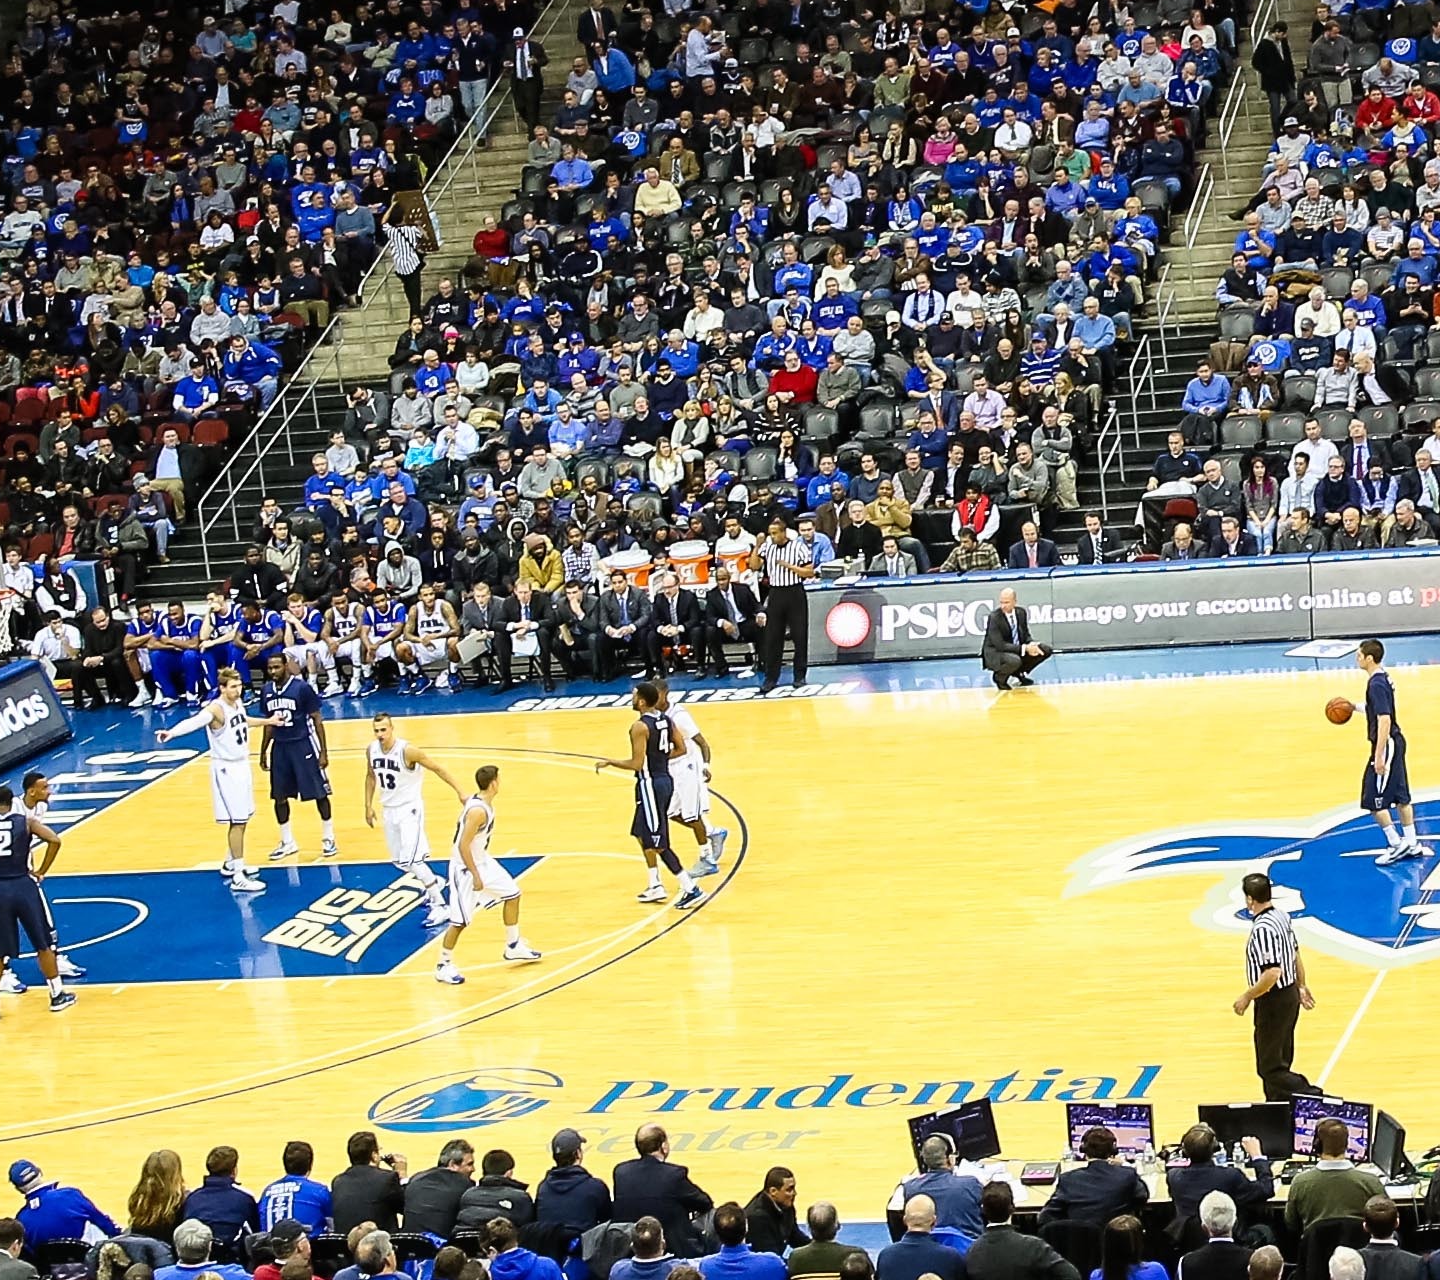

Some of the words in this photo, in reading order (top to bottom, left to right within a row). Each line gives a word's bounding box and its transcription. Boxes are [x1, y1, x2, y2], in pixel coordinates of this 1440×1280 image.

[1029, 603, 1127, 625] Manage
[1133, 603, 1182, 622] your
[1187, 594, 1293, 616] account
[1299, 587, 1382, 610] online
[1387, 586, 1414, 605] at
[658, 728, 669, 753] 4
[378, 772, 396, 789] 13
[261, 887, 371, 950] BIG
[583, 1065, 1164, 1113] Prudential
